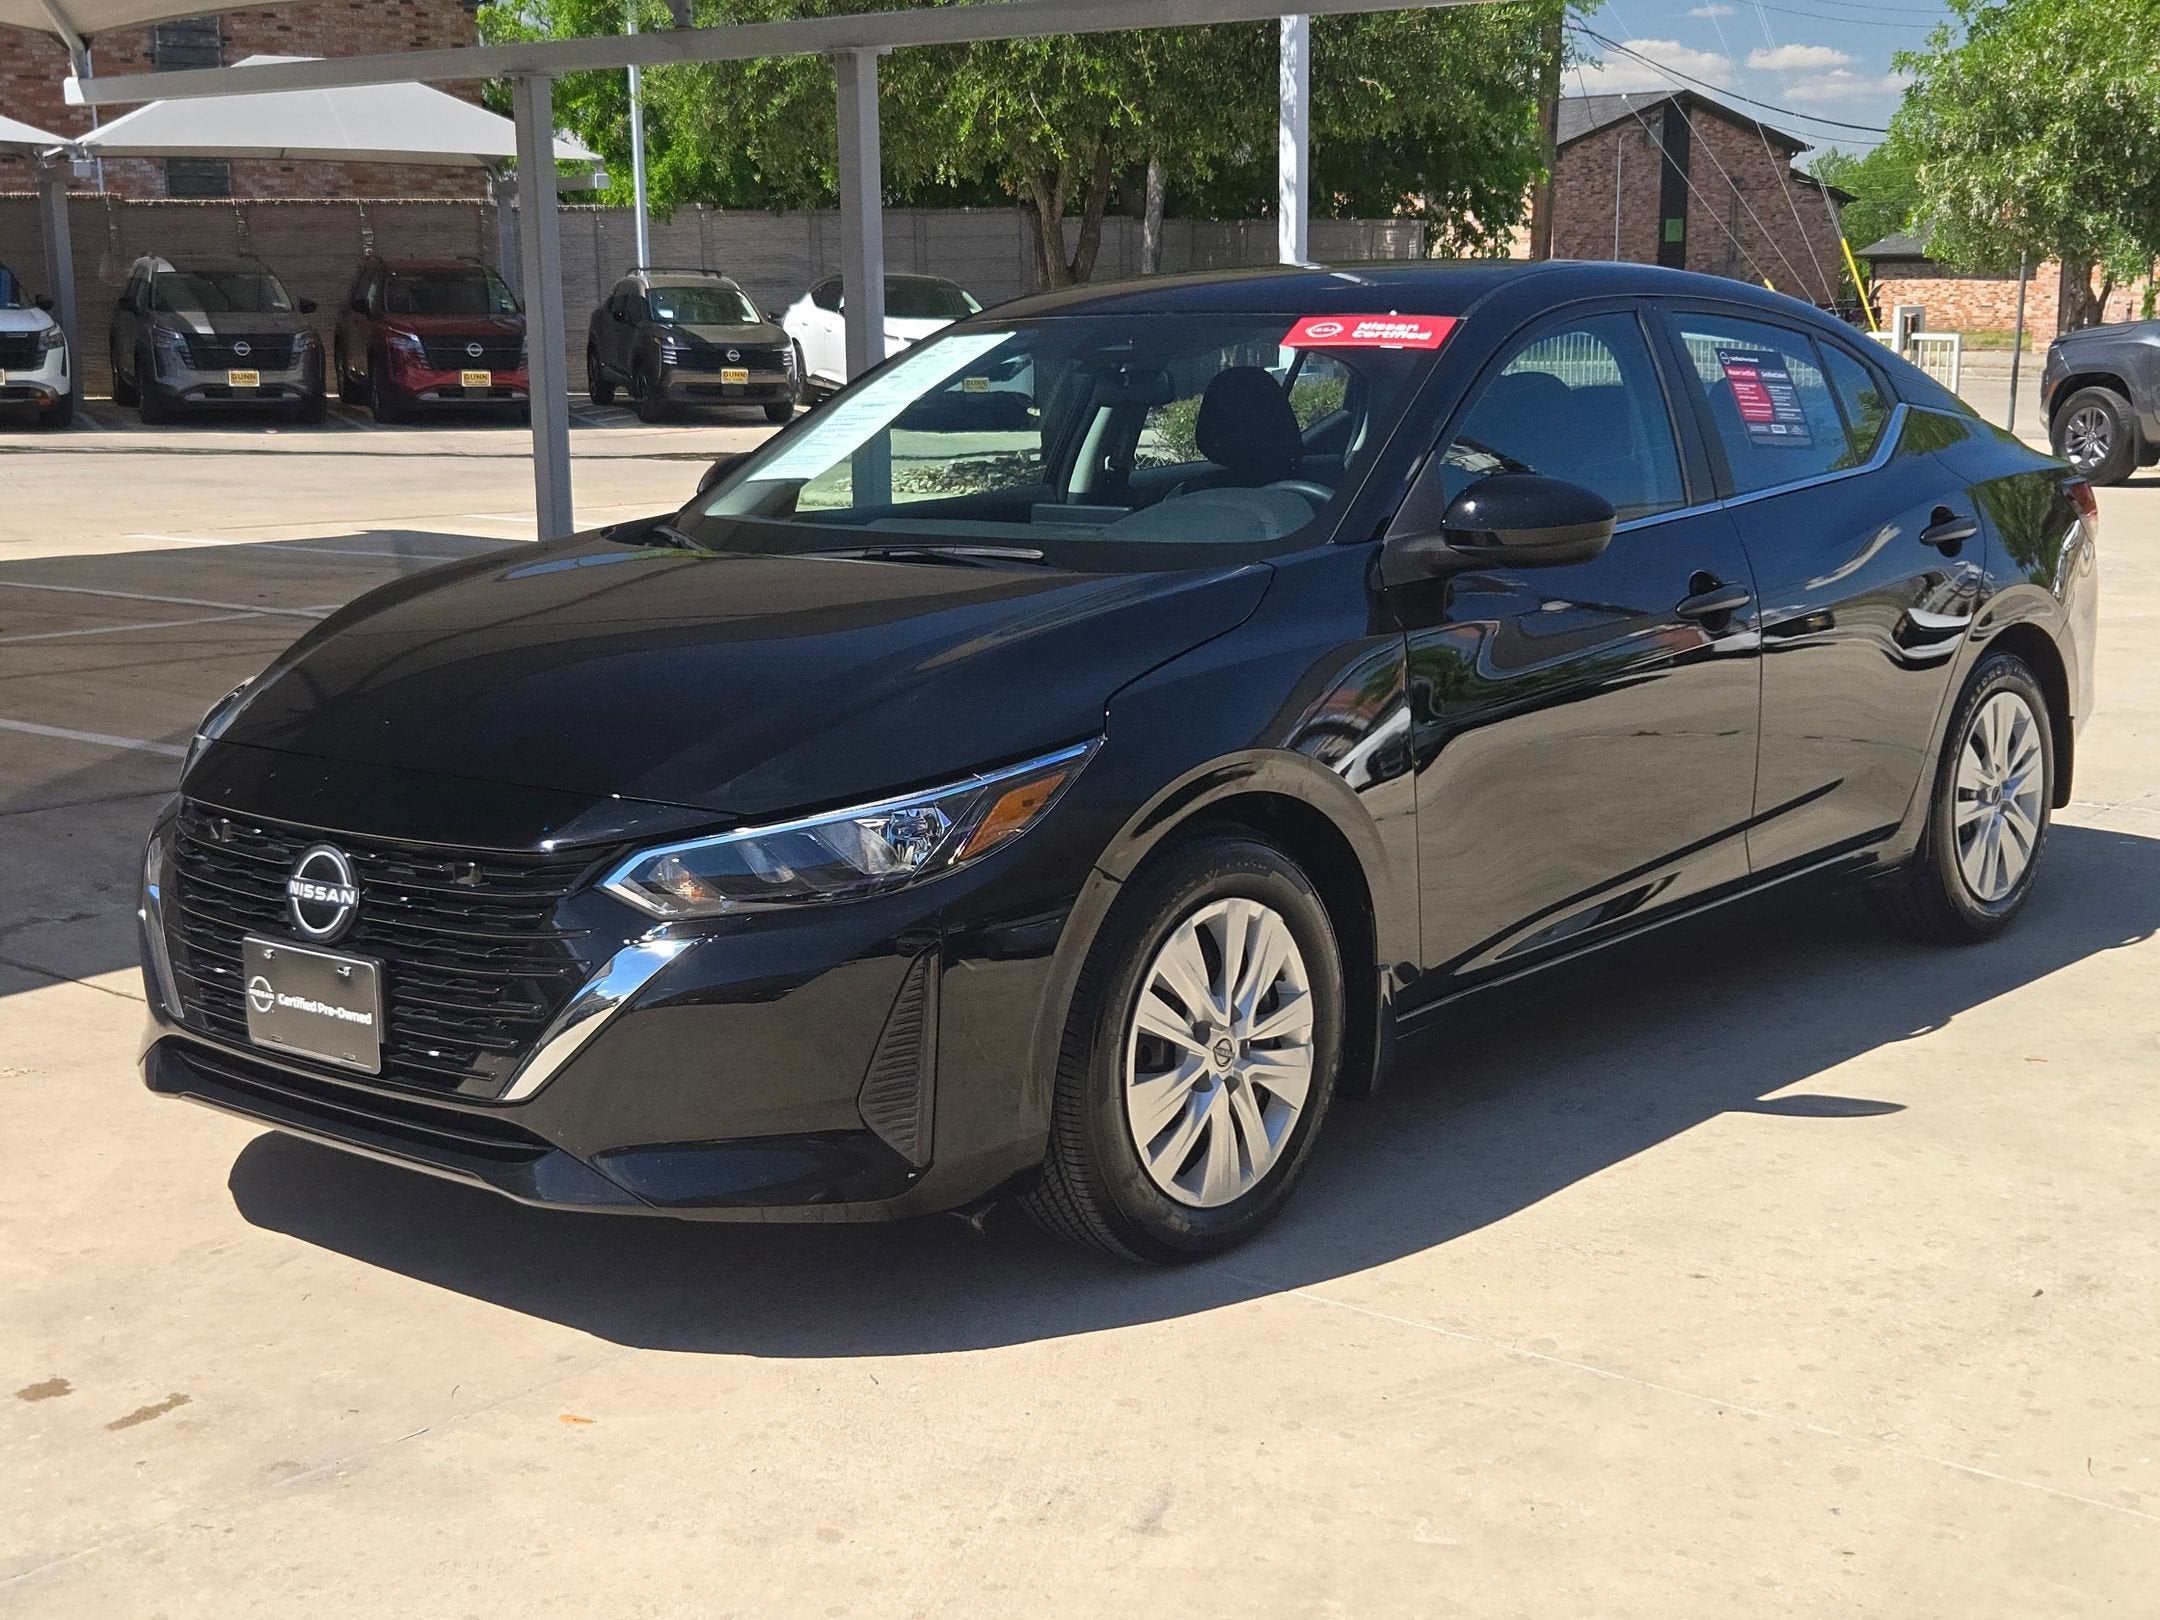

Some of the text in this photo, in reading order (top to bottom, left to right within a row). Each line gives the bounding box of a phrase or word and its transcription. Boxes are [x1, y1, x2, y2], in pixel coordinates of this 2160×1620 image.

[1351, 330, 1432, 340] Certified
[1358, 321, 1419, 332] Nissan
[289, 880, 356, 904] NISSAN
[277, 993, 373, 1025] Certified Pre-Owned
